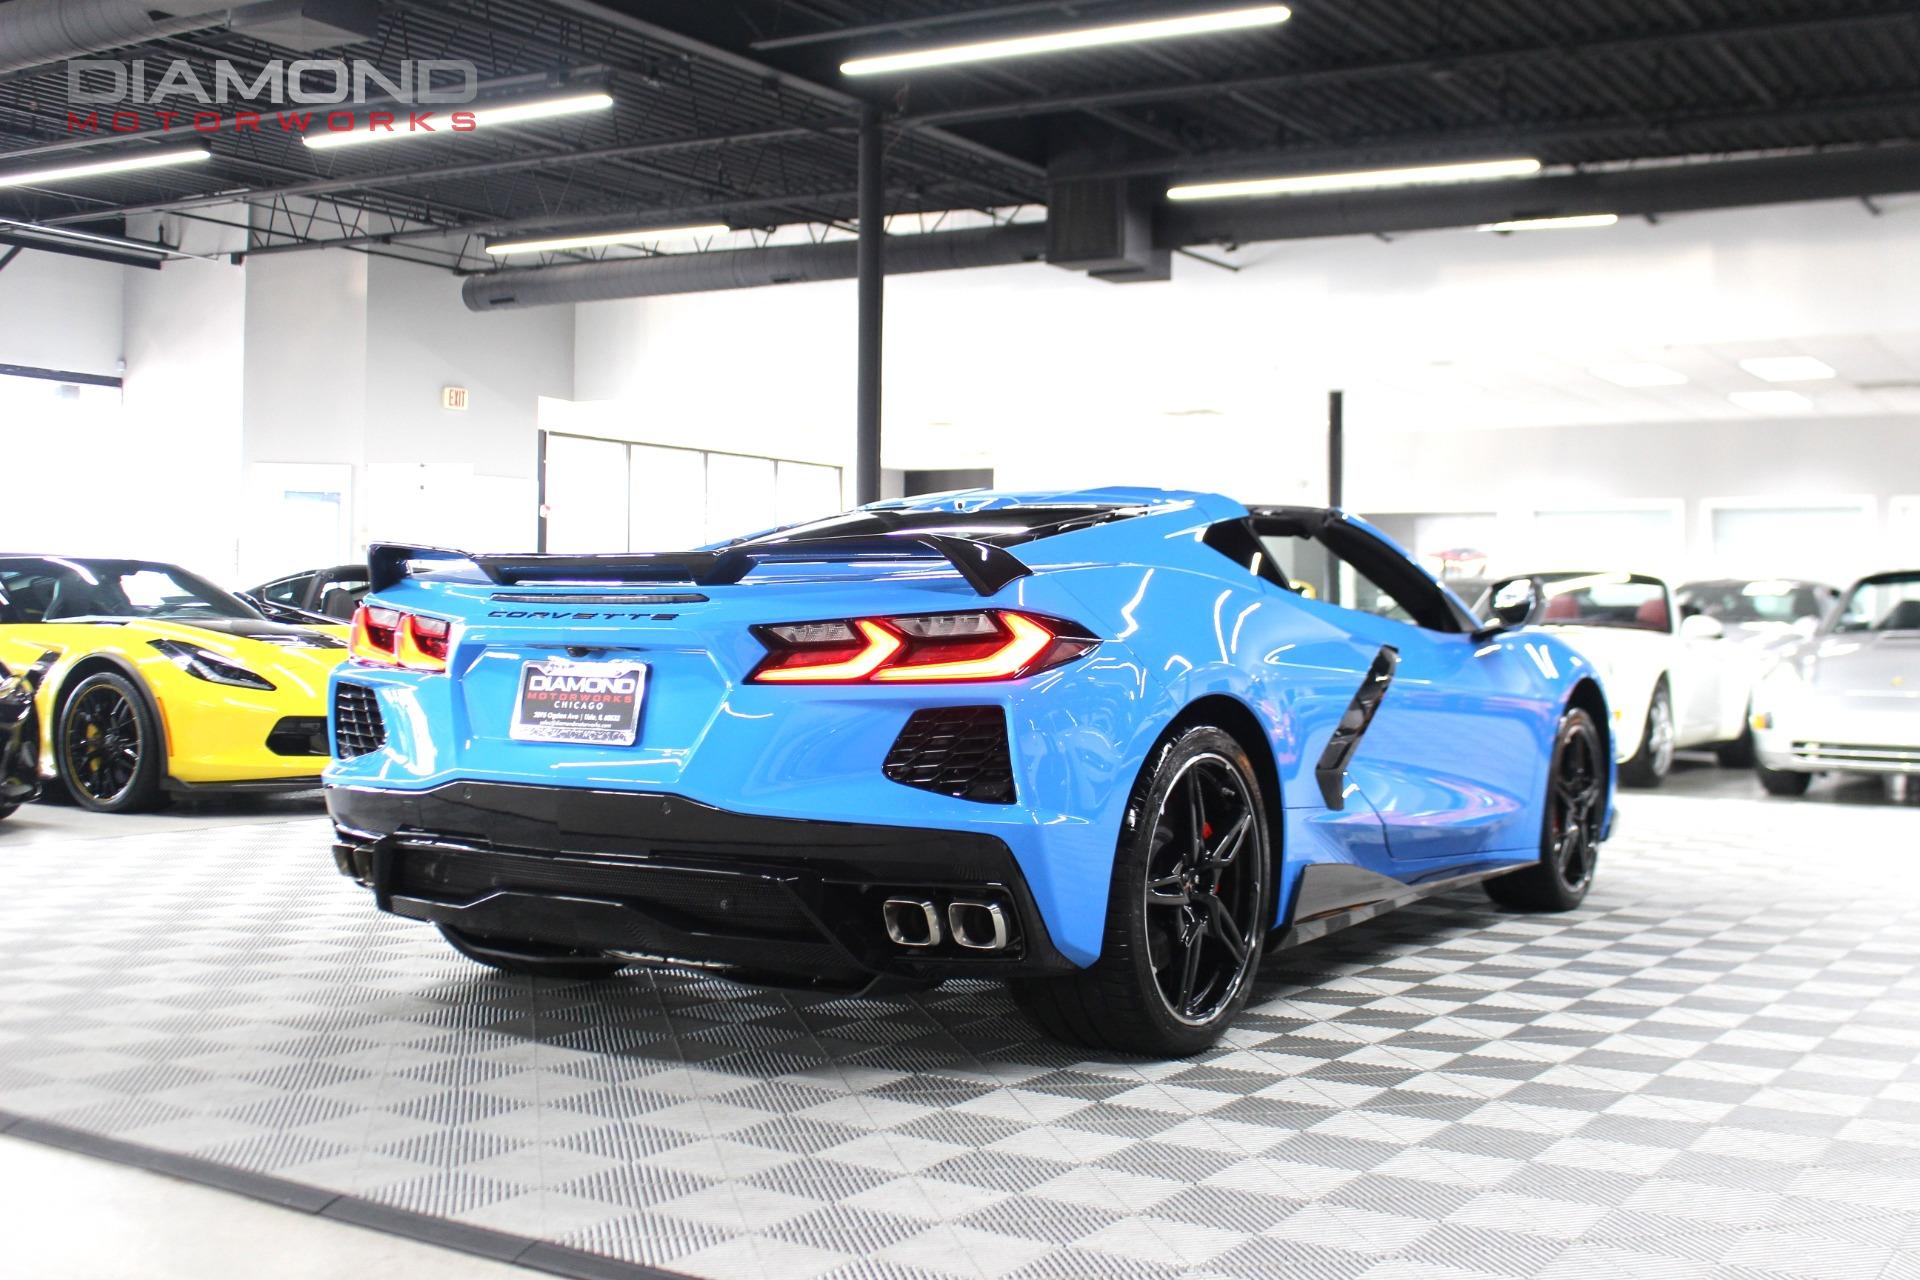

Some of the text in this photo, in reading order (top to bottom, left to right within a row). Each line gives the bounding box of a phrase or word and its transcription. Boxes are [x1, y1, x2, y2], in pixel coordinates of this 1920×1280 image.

[449, 389, 465, 407] EXIT
[487, 610, 680, 621] CORVETTE
[528, 675, 637, 694] DIAMOND
[526, 691, 633, 704] MOTORWORKS
[553, 700, 604, 711] CHICAGO
